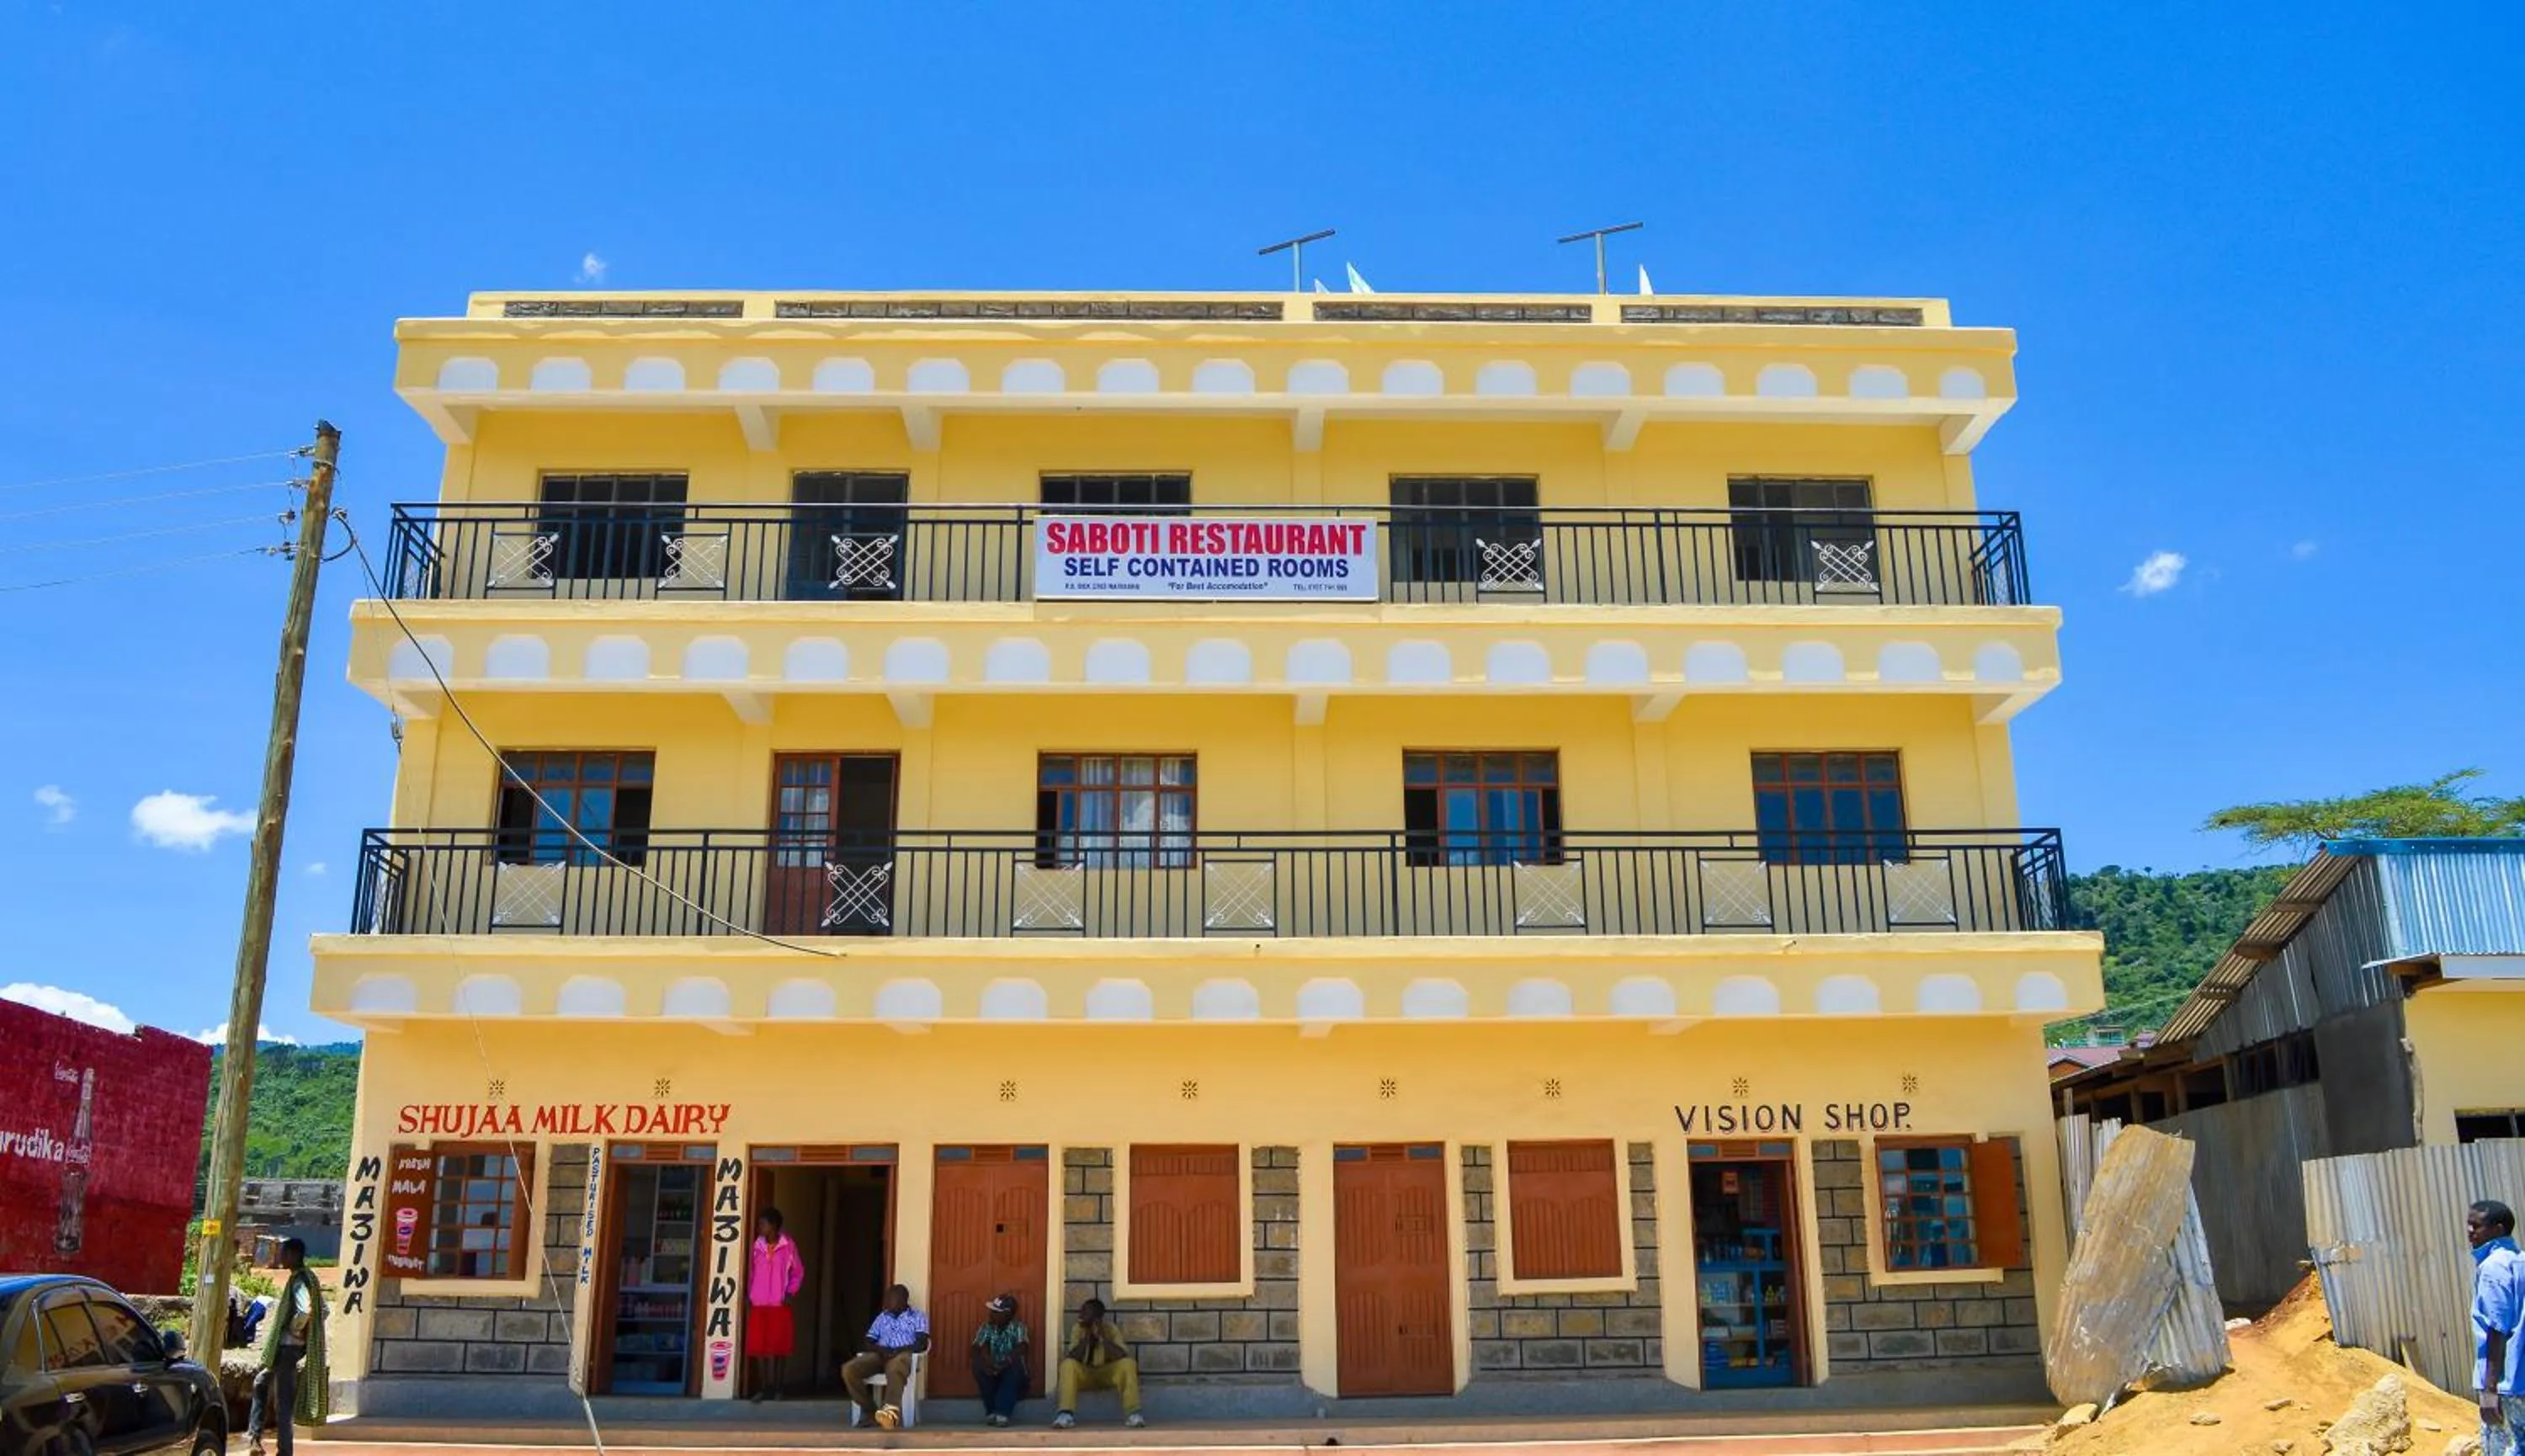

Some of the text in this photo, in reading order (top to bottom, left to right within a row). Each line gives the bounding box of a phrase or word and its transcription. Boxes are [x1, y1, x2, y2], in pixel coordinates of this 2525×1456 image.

[1046, 523, 1366, 555] SABOTI RESTAURANT
[1064, 557, 1348, 579] SELF CONTAINED ROOMS
[398, 1103, 731, 1139] SHUJAA MILK DAIRY
[1675, 1103, 1803, 1133] VISION
